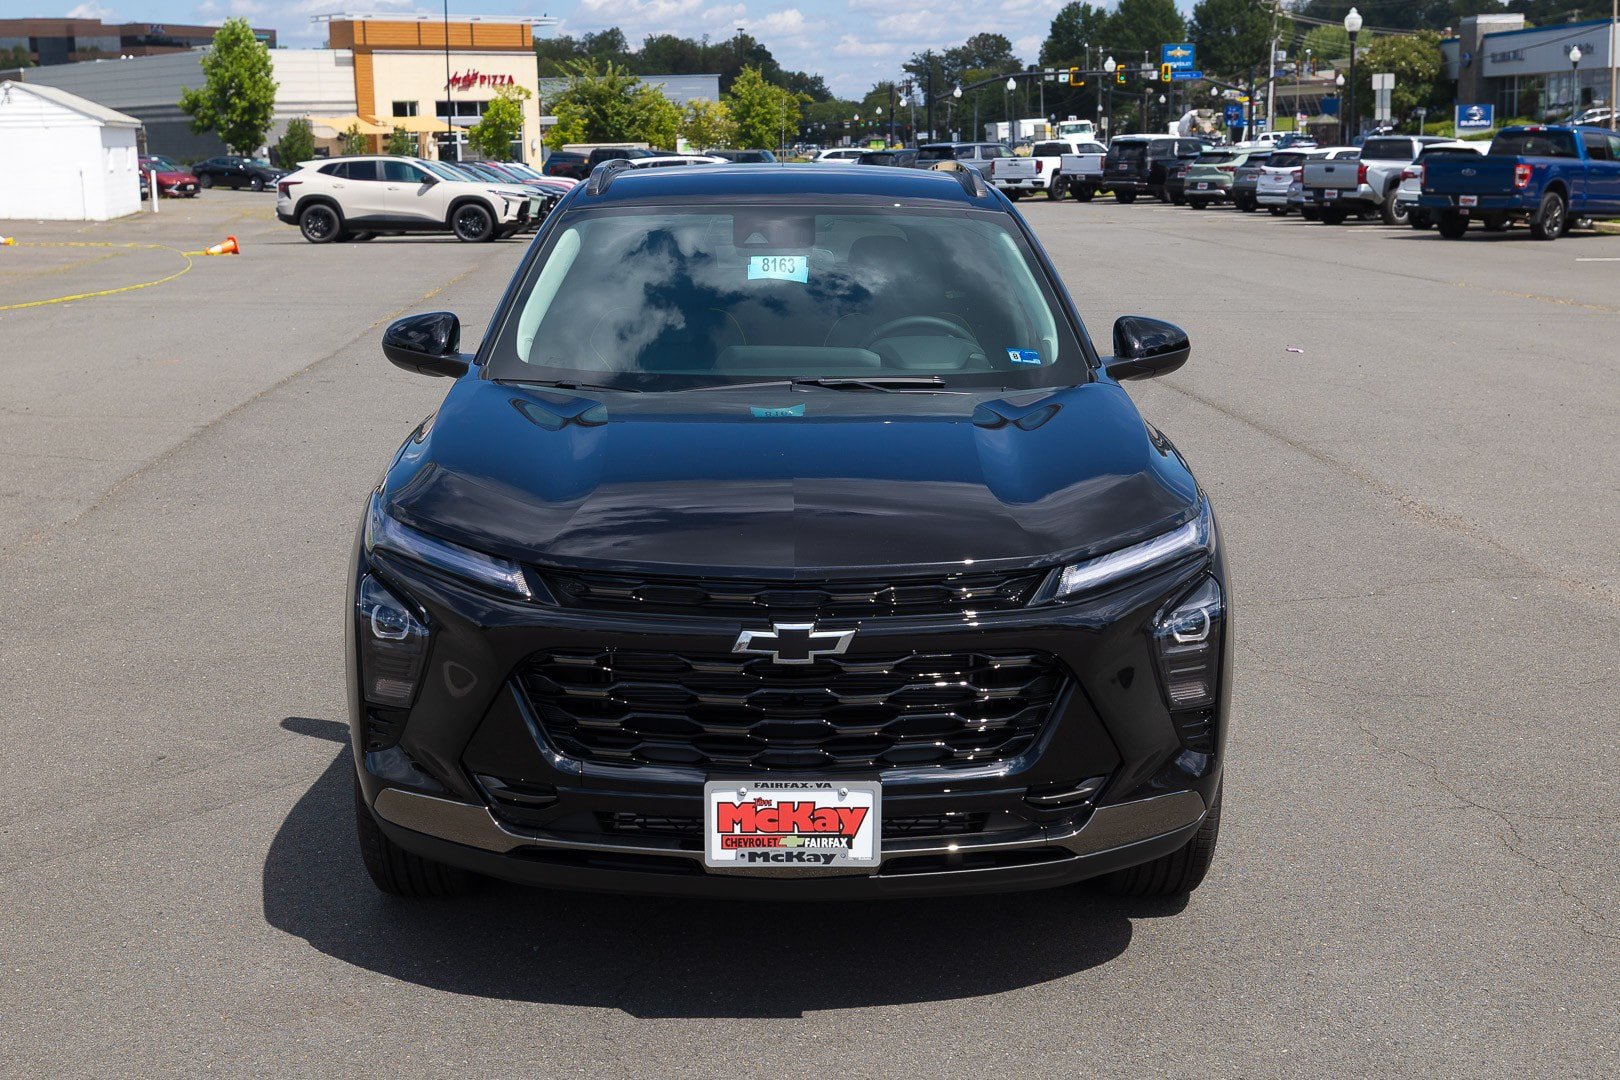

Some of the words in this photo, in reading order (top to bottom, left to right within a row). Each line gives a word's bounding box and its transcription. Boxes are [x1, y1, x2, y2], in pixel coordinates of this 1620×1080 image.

[480, 74, 514, 86] PIZZA
[762, 258, 795, 274] 8163
[717, 801, 870, 839] McKay
[725, 837, 779, 848] CHEVROLET
[804, 837, 848, 848] FAIRFAX
[748, 851, 838, 864] McKay
